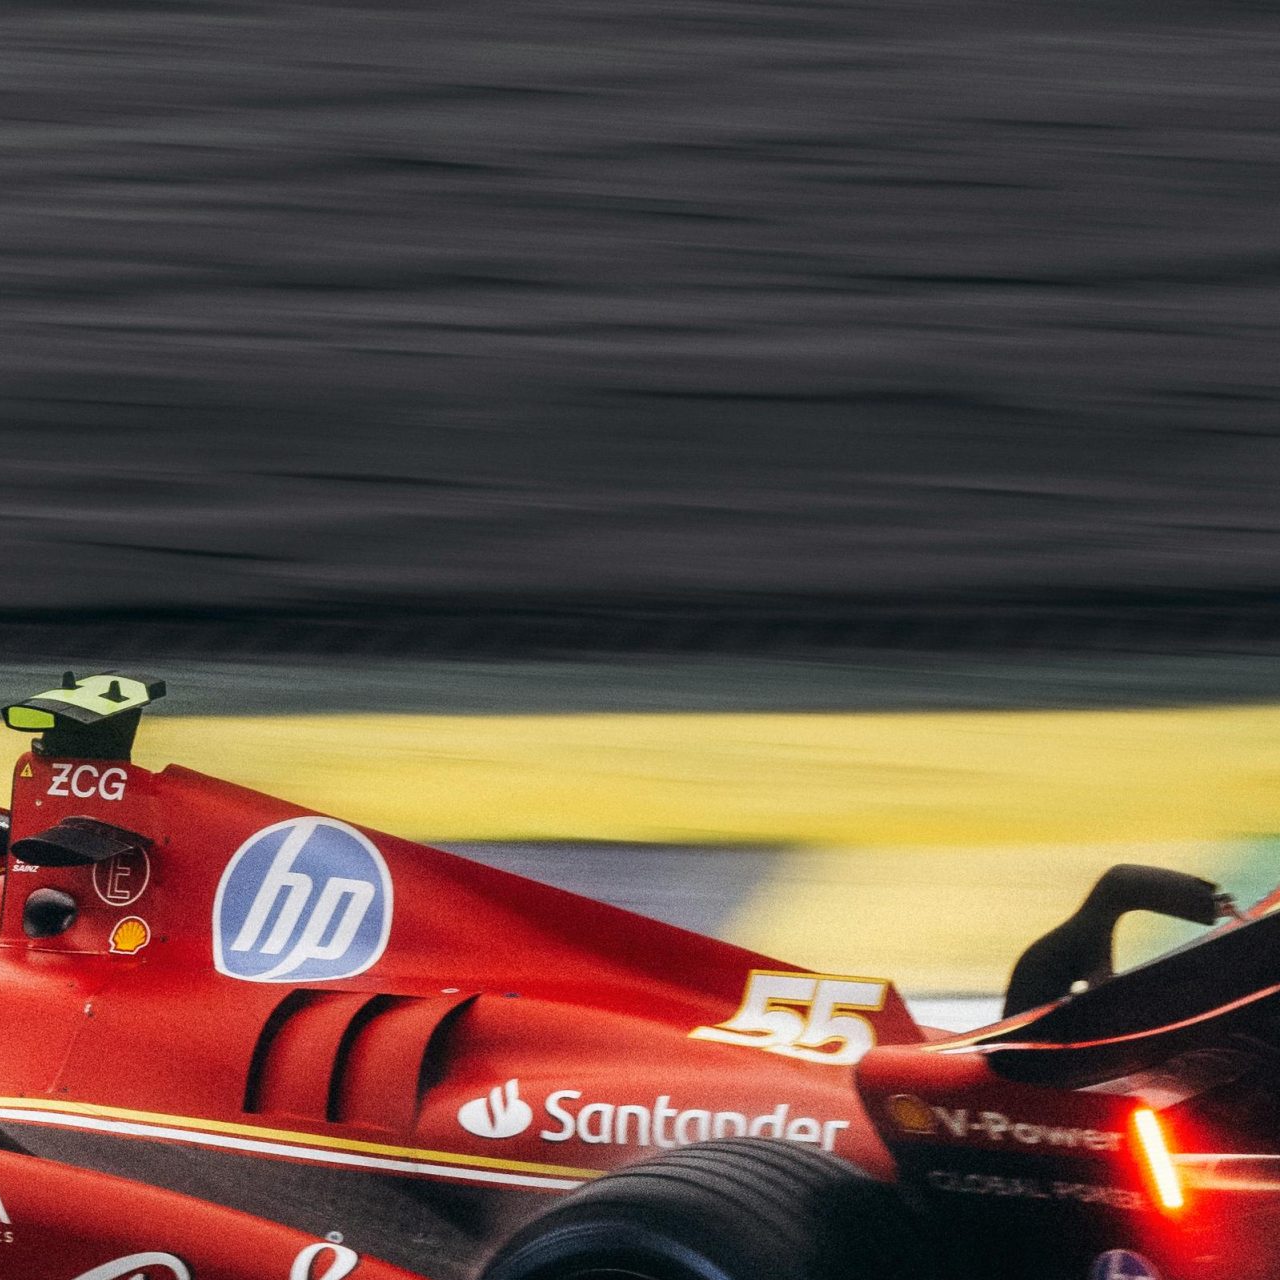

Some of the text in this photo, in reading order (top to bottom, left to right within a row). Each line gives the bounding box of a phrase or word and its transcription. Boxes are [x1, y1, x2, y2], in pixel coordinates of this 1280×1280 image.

[46, 763, 128, 801] ZCG
[224, 818, 380, 980] hp
[687, 969, 893, 1066] 55
[540, 1089, 851, 1151] Santander
